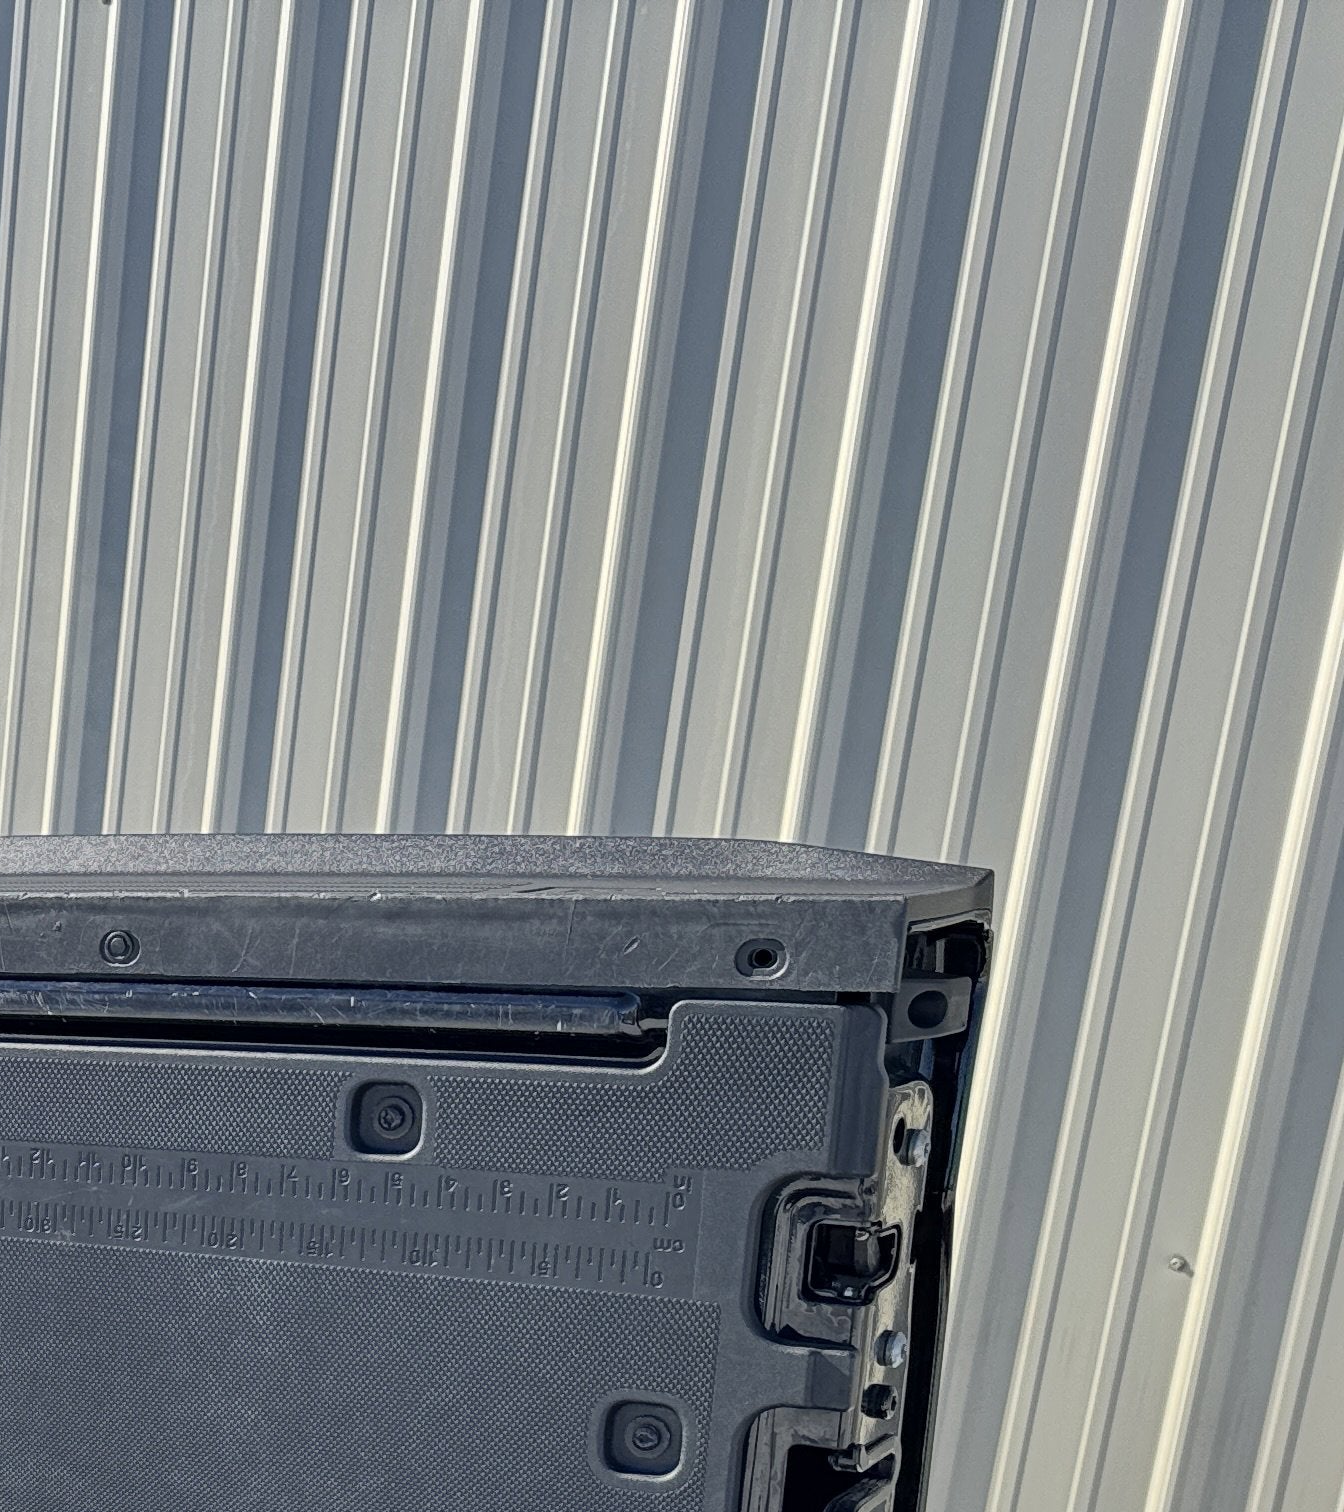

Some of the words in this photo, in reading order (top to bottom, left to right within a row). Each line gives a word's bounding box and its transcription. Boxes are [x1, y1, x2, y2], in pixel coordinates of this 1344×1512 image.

[30, 1148, 53, 1164] 12
[79, 1152, 100, 1167] 11
[122, 1154, 146, 1170] 10
[187, 1158, 198, 1175] 9
[238, 1161, 249, 1178] 8
[287, 1165, 299, 1181] 7
[338, 1168, 351, 1185] 6
[391, 1172, 404, 1189] 5
[445, 1176, 458, 1192] 4
[500, 1180, 513, 1197] 3
[556, 1183, 569, 1200] 2
[613, 1188, 622, 1205] 1
[673, 1192, 685, 1210] 0
[25, 1216, 51, 1233] 30
[114, 1225, 142, 1241] 25
[208, 1231, 237, 1249] 20
[308, 1240, 334, 1257] 15
[653, 1238, 684, 1253] cm
[410, 1249, 438, 1266] 10
[539, 1261, 549, 1277] 5
[651, 1271, 662, 1288] 0
